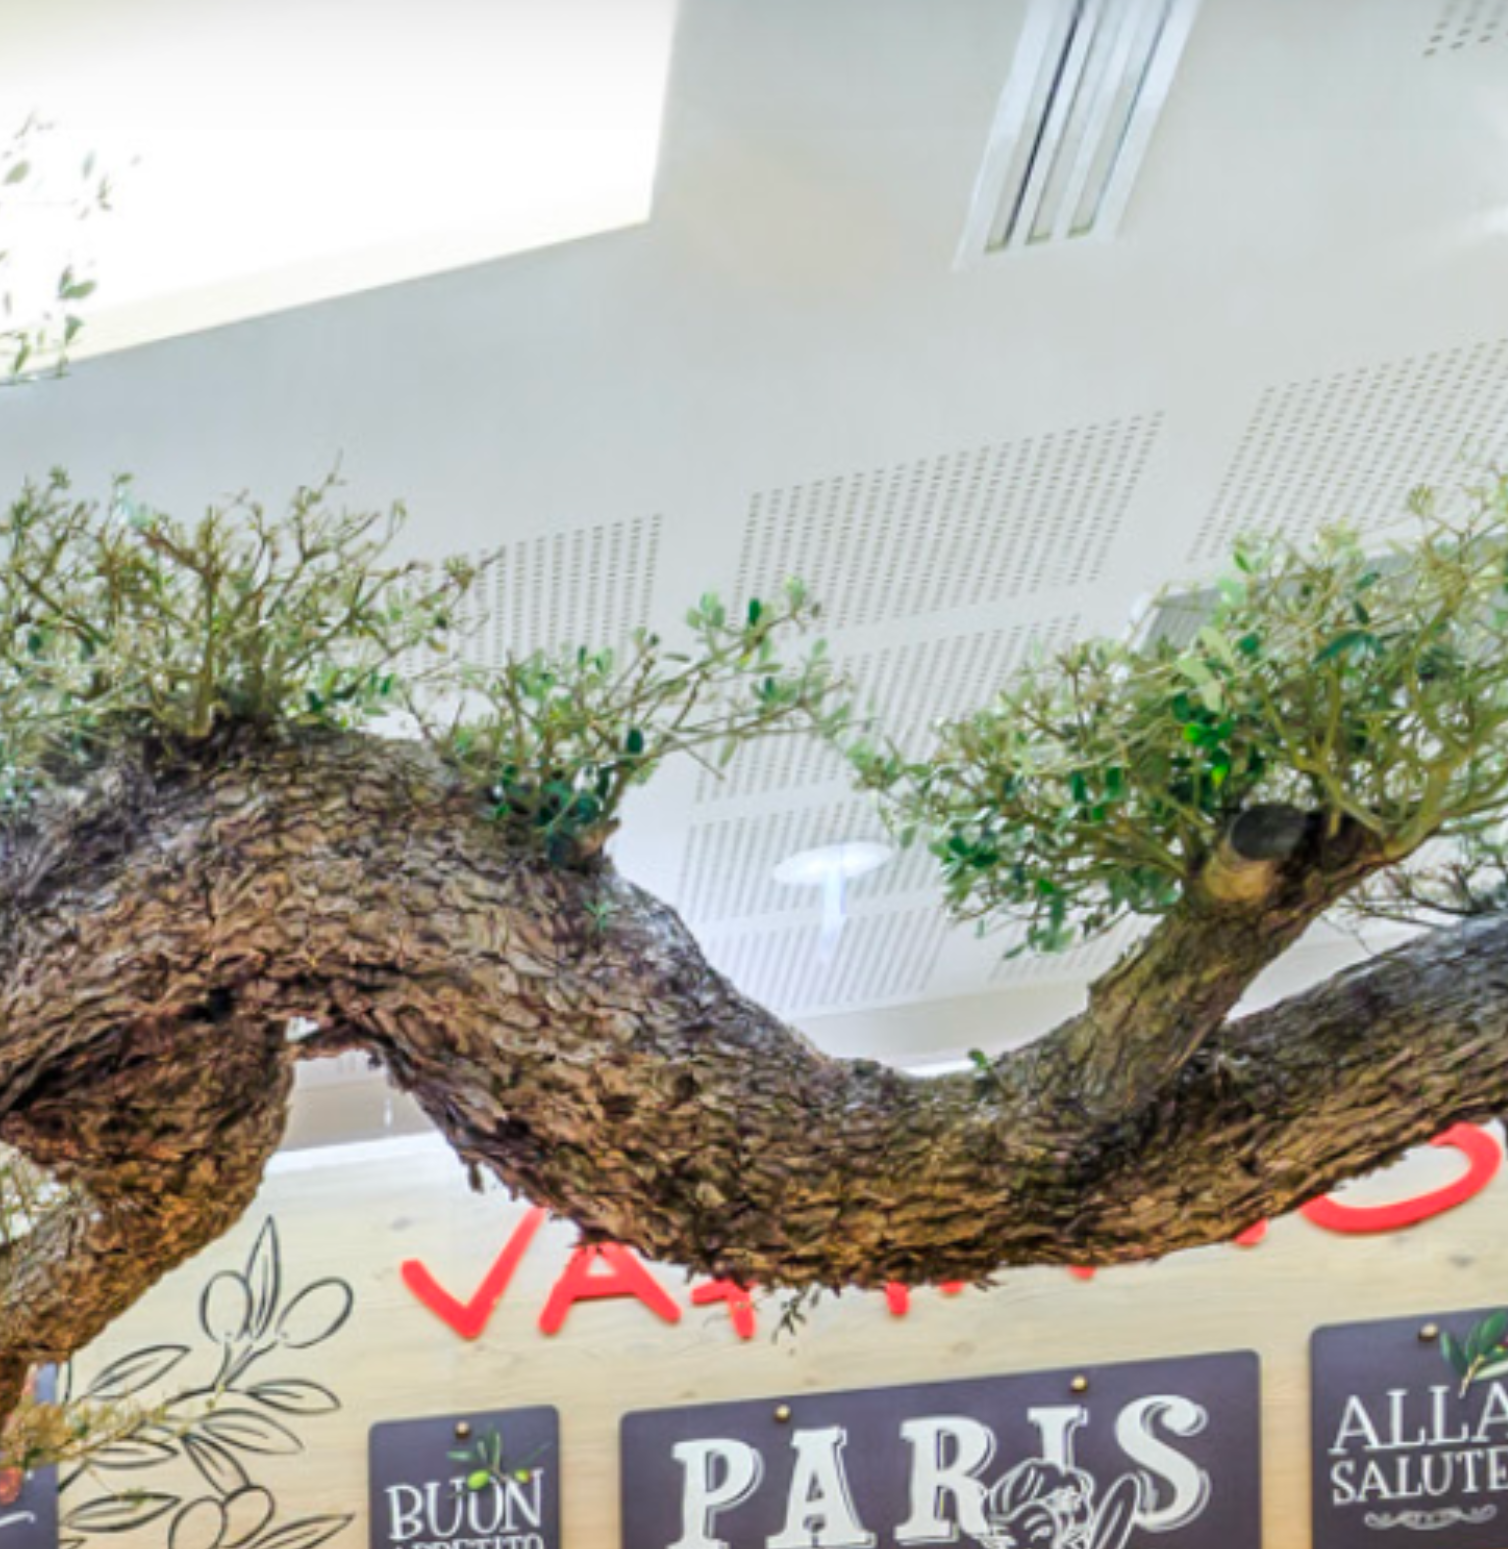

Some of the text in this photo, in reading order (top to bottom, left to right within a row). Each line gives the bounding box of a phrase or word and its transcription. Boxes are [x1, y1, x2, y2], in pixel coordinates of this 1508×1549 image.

[1328, 1381, 1508, 1455] ALLA
[384, 1467, 544, 1541] BUON
[1330, 1446, 1508, 1505] SALUTE
